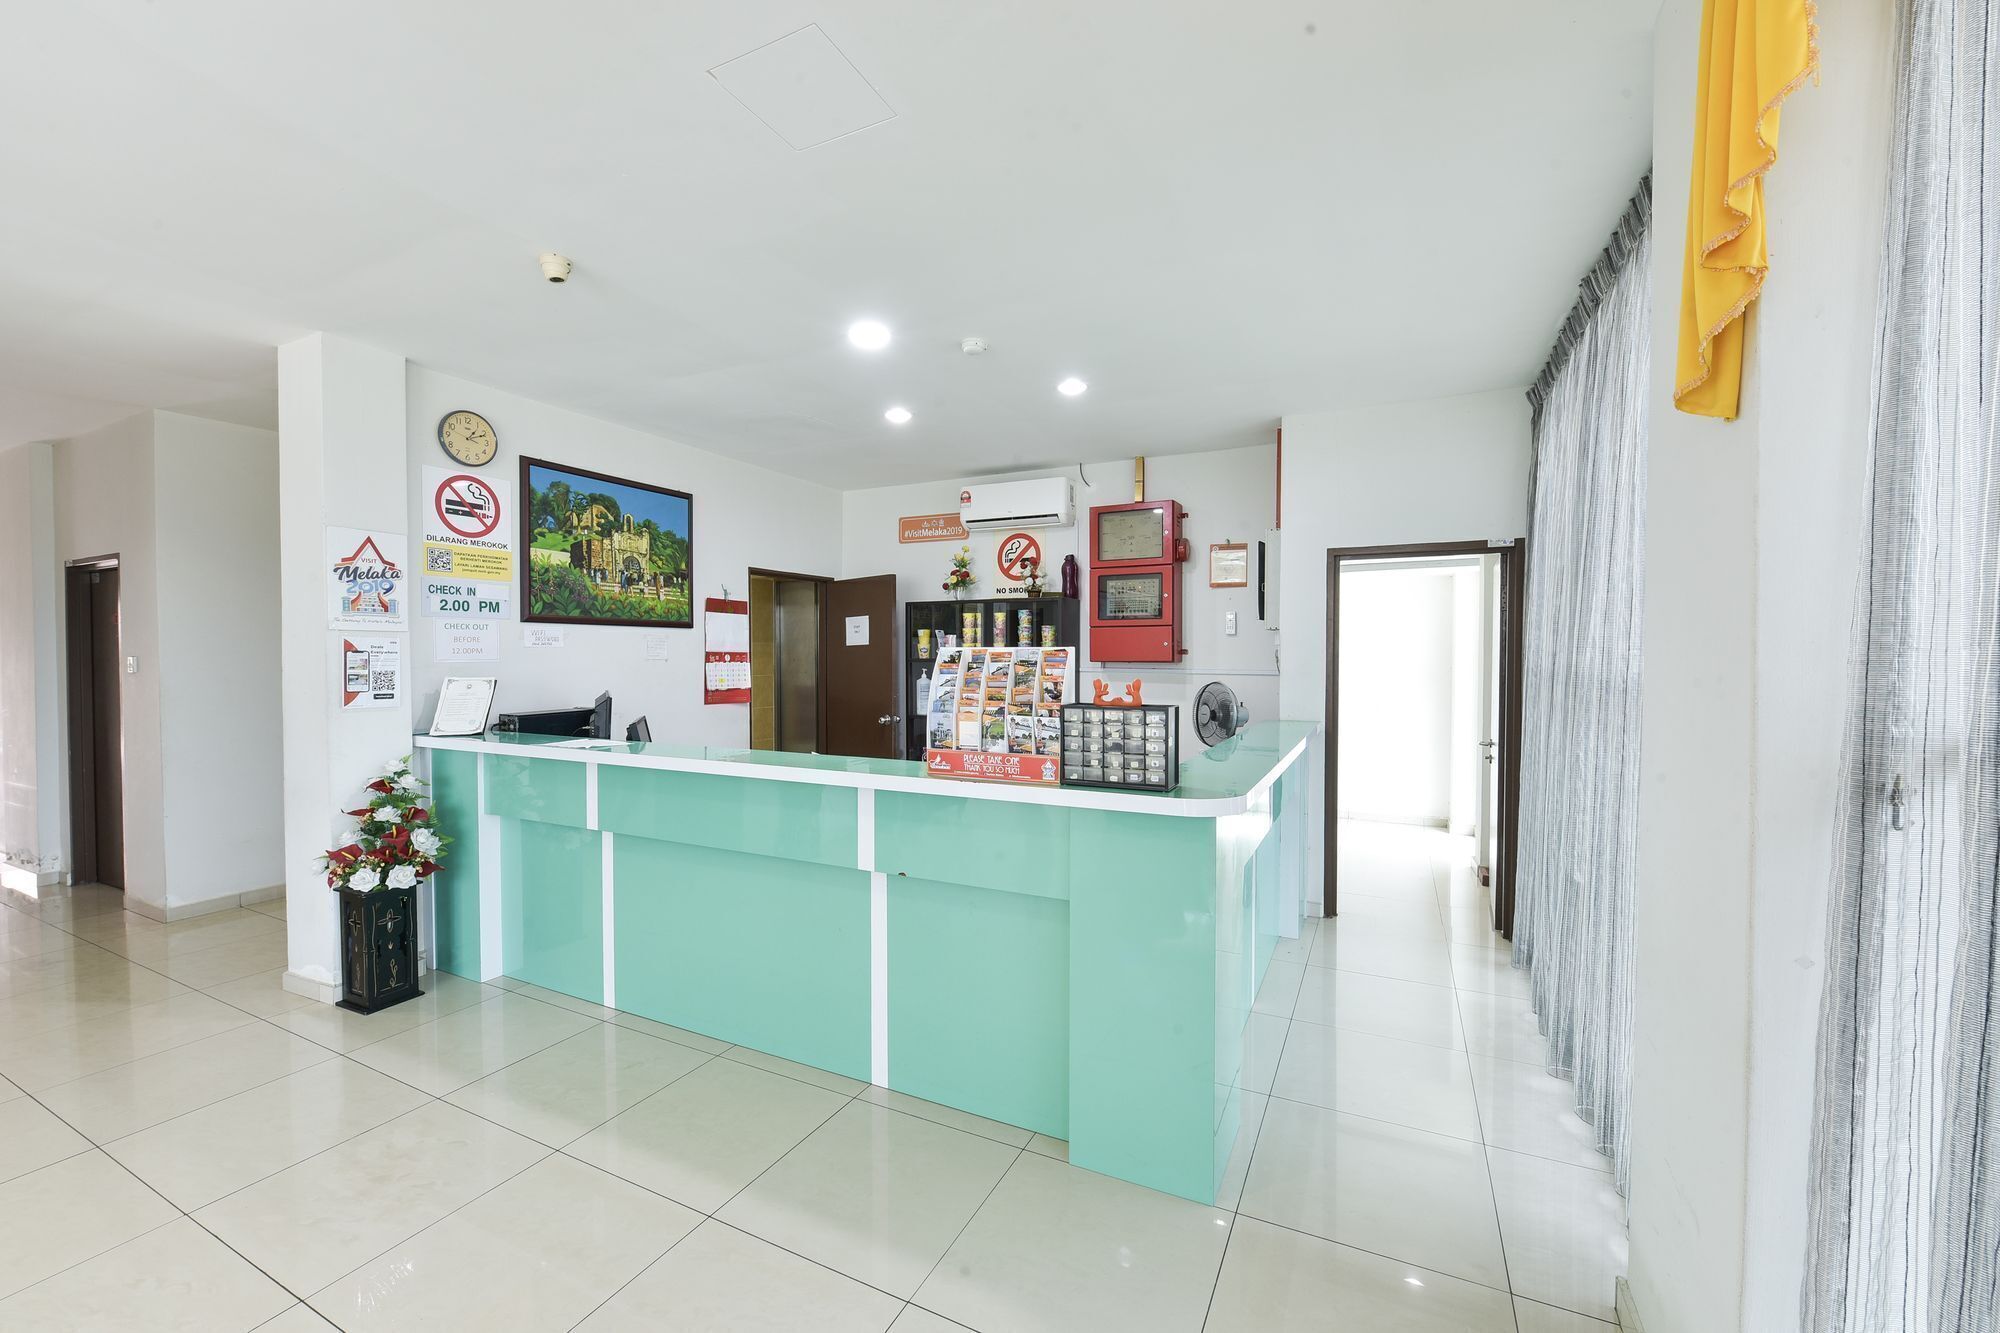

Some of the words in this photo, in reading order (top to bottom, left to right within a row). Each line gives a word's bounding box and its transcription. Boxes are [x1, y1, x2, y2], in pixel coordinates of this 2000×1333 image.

[905, 526, 963, 538] #VisitMelaka2019
[426, 534, 468, 546] DILARANG
[470, 540, 508, 549] MEROKOK
[333, 565, 402, 581] Melaka
[346, 579, 395, 594] 2019
[428, 584, 462, 595] CHECK
[467, 587, 476, 596] IN
[440, 599, 470, 612] 2.00
[479, 601, 500, 613] PM
[444, 622, 470, 630] CHECK
[963, 754, 985, 764] PLEASE
[987, 755, 1002, 764] TAKE
[1004, 757, 1020, 766] ONE
[964, 763, 981, 772] THANK
[983, 765, 995, 773] YOU
[1005, 766, 1020, 775] MUCH
